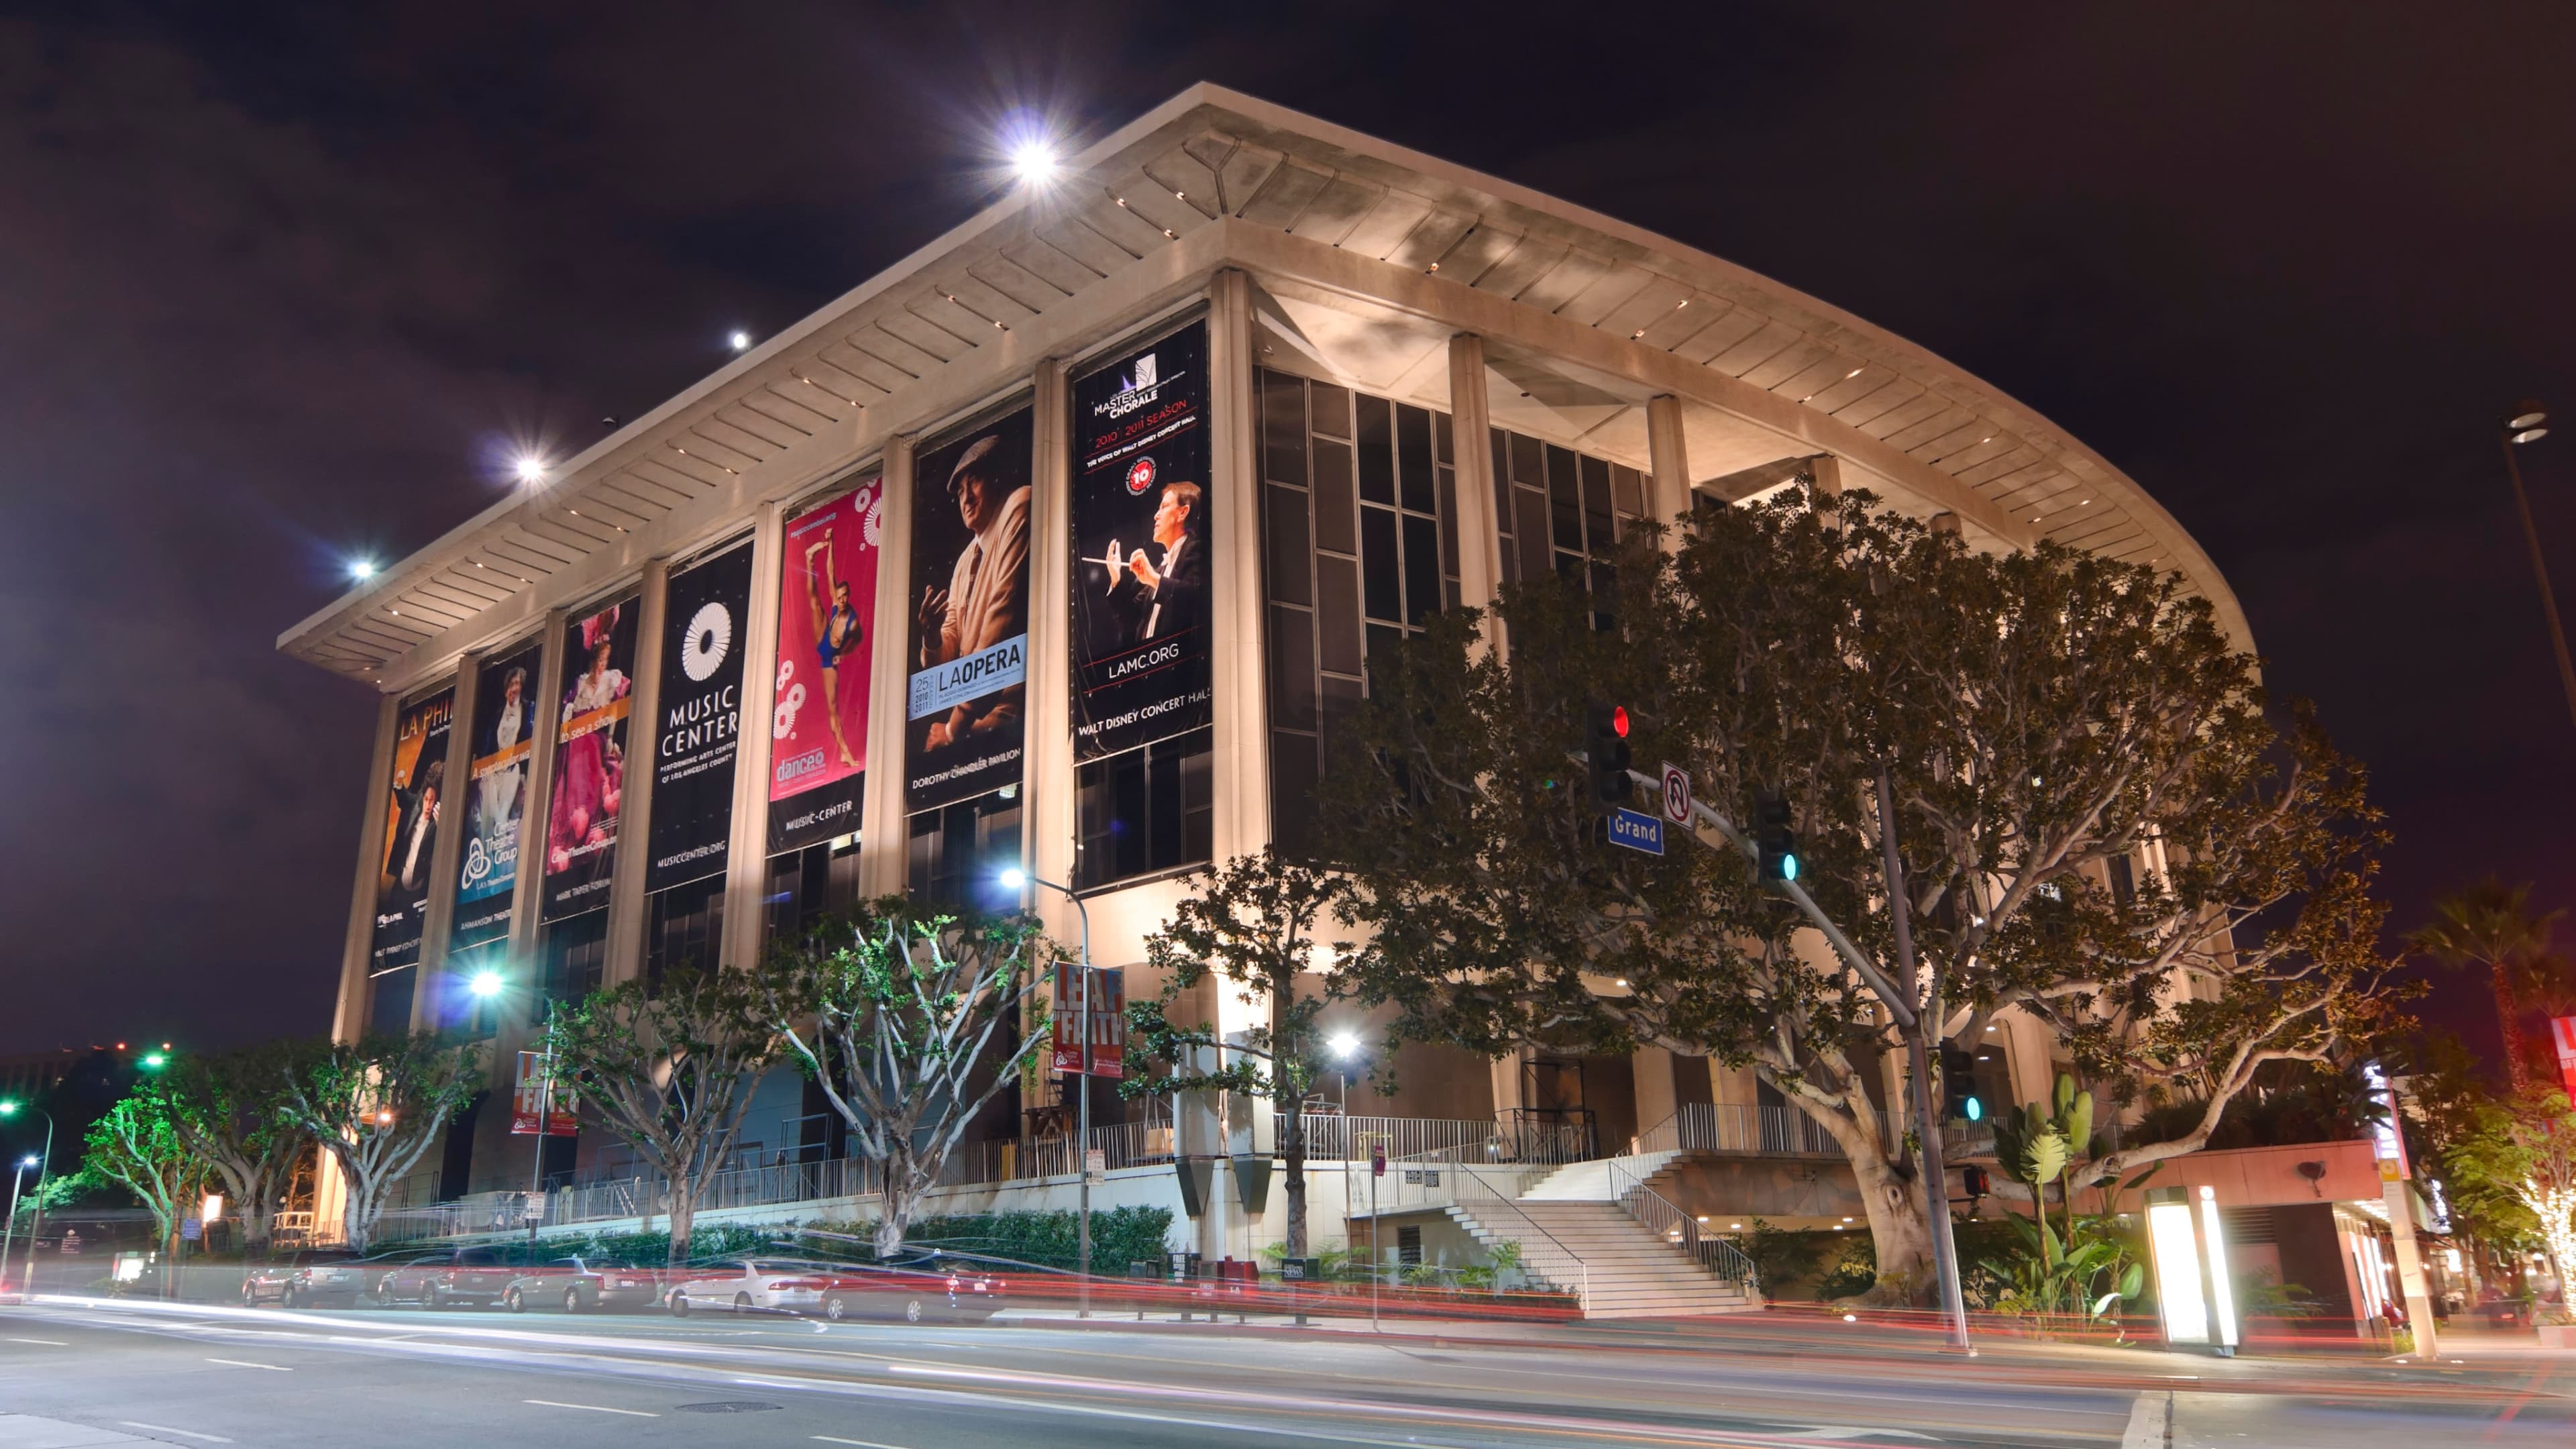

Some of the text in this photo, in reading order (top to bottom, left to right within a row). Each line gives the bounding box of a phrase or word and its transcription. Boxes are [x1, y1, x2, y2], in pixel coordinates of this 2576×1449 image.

[1095, 390, 1135, 417] MASTER
[1110, 390, 1158, 419] CHORALE
[1095, 400, 1187, 449] 2010 2011 SEASON
[1113, 449, 1122, 457] OF
[1133, 469, 1149, 484] 10
[1108, 643, 1179, 679] LAMC.ORG
[915, 692, 928, 704] 2010
[916, 676, 929, 693] 25
[400, 713, 418, 741] LA
[423, 698, 453, 731] PHIL
[669, 684, 734, 729] MUSIC
[915, 702, 928, 713] 2011
[1078, 720, 1104, 736] WALT
[1106, 710, 1138, 730] DISNEY
[1140, 695, 1185, 719] CONCERT
[662, 711, 738, 757] CENTER
[660, 741, 737, 772] PERFORMING ARTS CENTER
[661, 753, 733, 784] OF LOS ANGELES COUNTY
[912, 747, 1021, 790] DOROTHY CHANDLER PAVILION
[472, 767, 478, 781] A
[818, 800, 853, 821] CENTER
[494, 818, 521, 837] Center
[1615, 814, 1657, 843] Grand
[485, 833, 515, 853] Theatre
[494, 847, 518, 866] Group
[590, 877, 612, 890] FORUM
[460, 914, 493, 930] AHMANSON
[1054, 963, 1122, 1012] LEAP
[1061, 1010, 1122, 1045] FAITH
